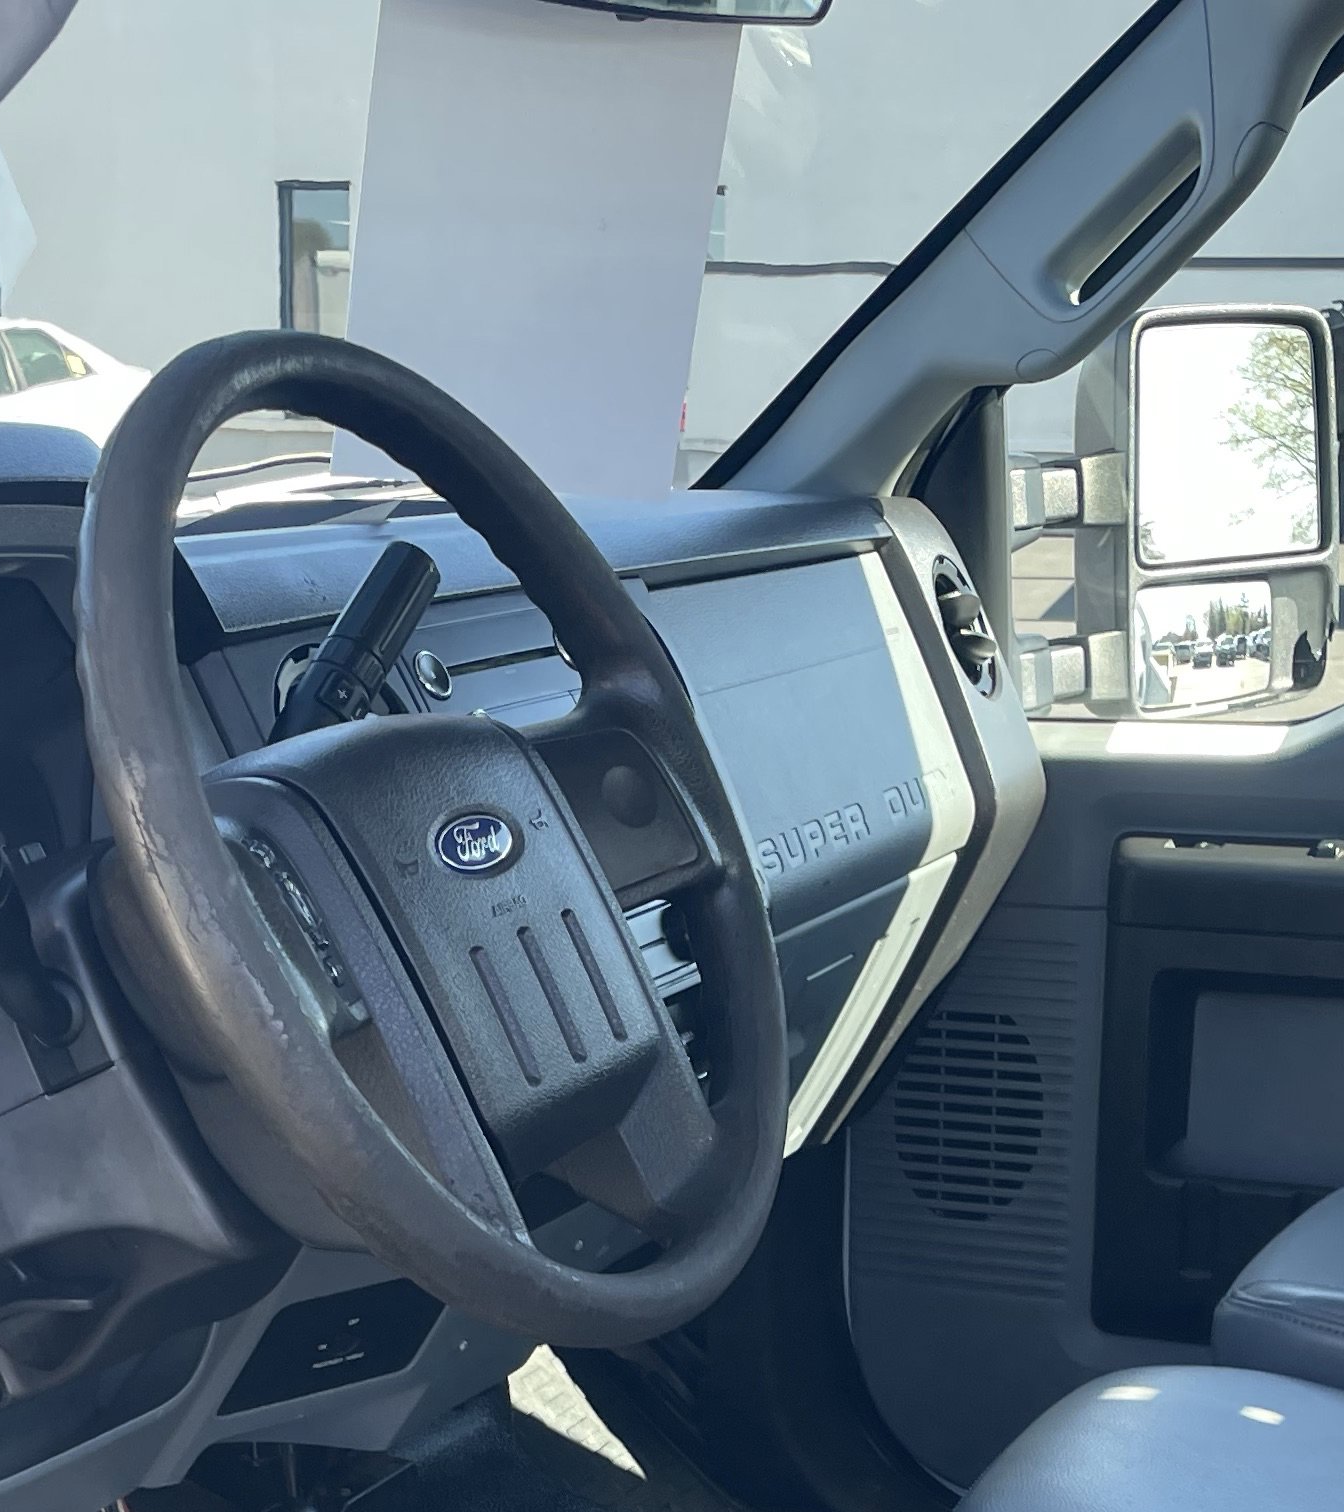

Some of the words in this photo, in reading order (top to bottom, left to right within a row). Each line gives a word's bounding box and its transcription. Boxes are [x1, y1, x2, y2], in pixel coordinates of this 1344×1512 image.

[452, 821, 501, 862] Ford
[757, 801, 871, 875] SUPER
[882, 766, 955, 825] DU
